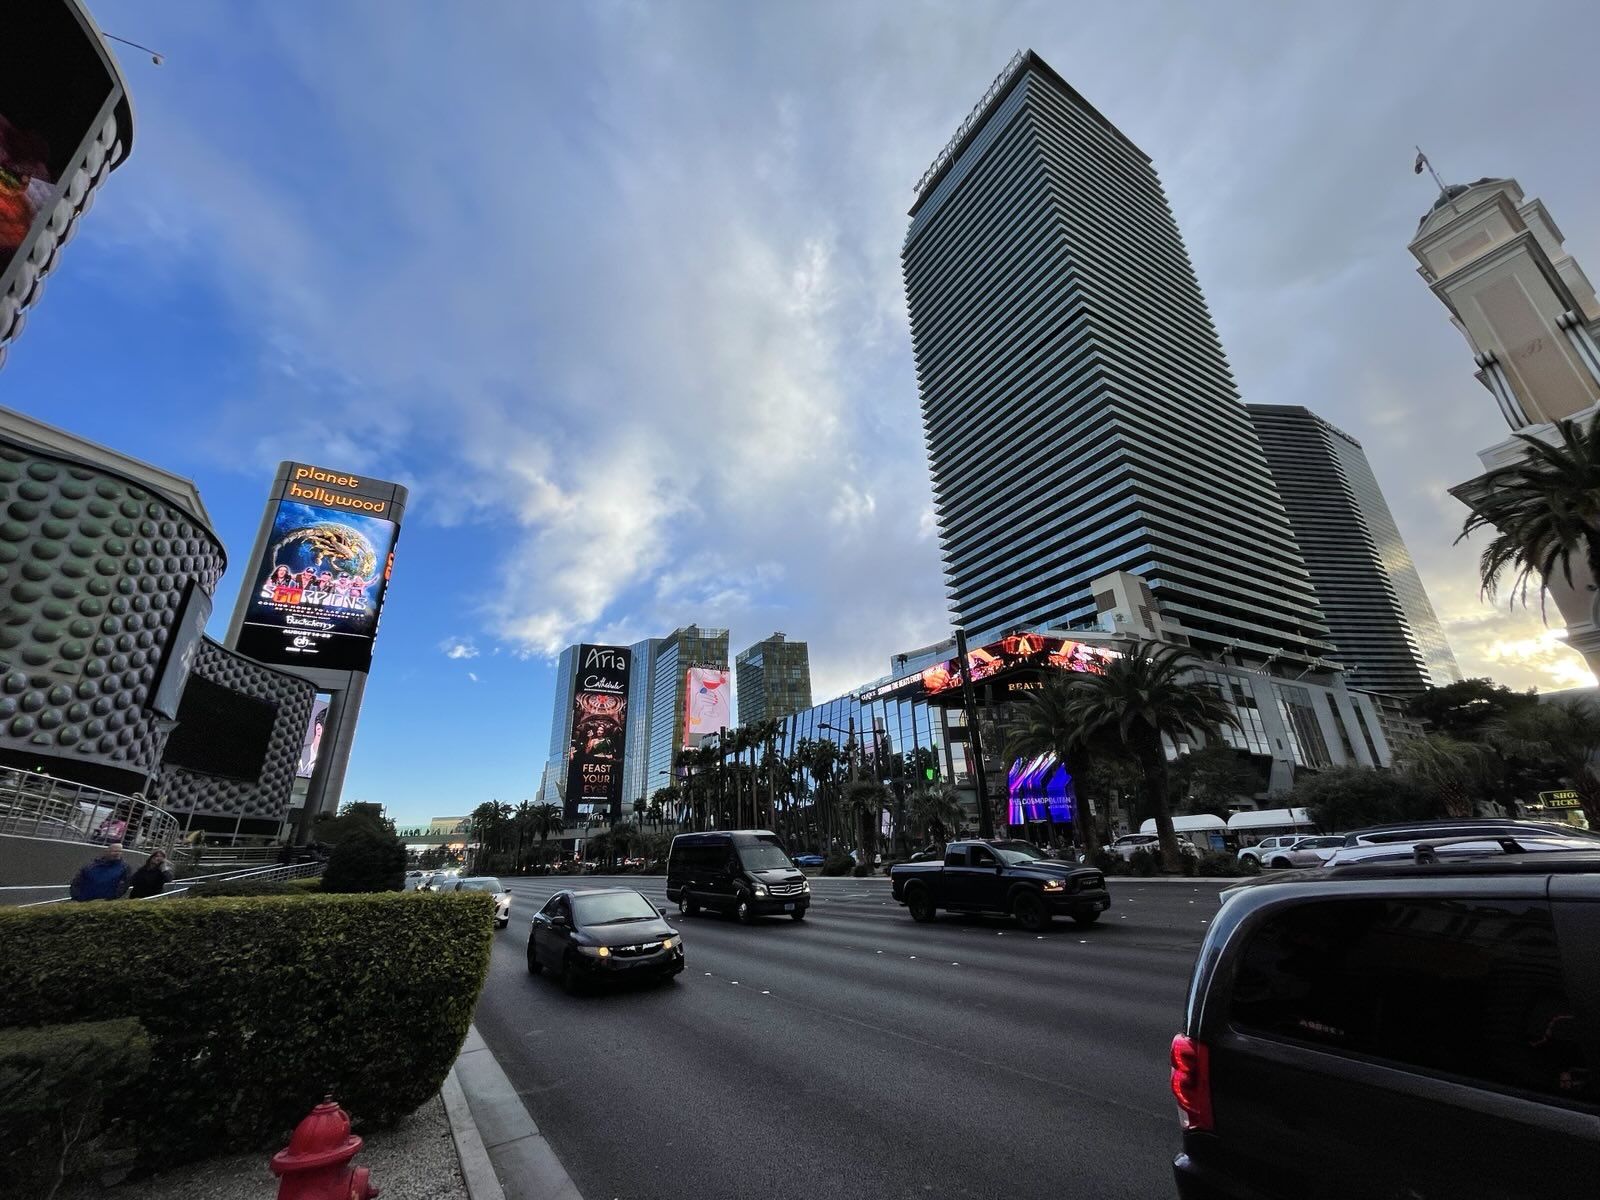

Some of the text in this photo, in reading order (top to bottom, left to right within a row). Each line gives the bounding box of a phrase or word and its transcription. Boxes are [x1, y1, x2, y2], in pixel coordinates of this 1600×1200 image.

[296, 466, 359, 488] planet
[289, 483, 385, 512] hollywood
[260, 584, 368, 610] SCORPIONS
[585, 648, 626, 670] Aria
[1008, 682, 1045, 691] BEAUT
[582, 763, 612, 773] FEAST
[583, 774, 610, 783] YOUR
[1021, 796, 1072, 806] COSMOPOLITAN
[1549, 799, 1581, 807] TICKE
